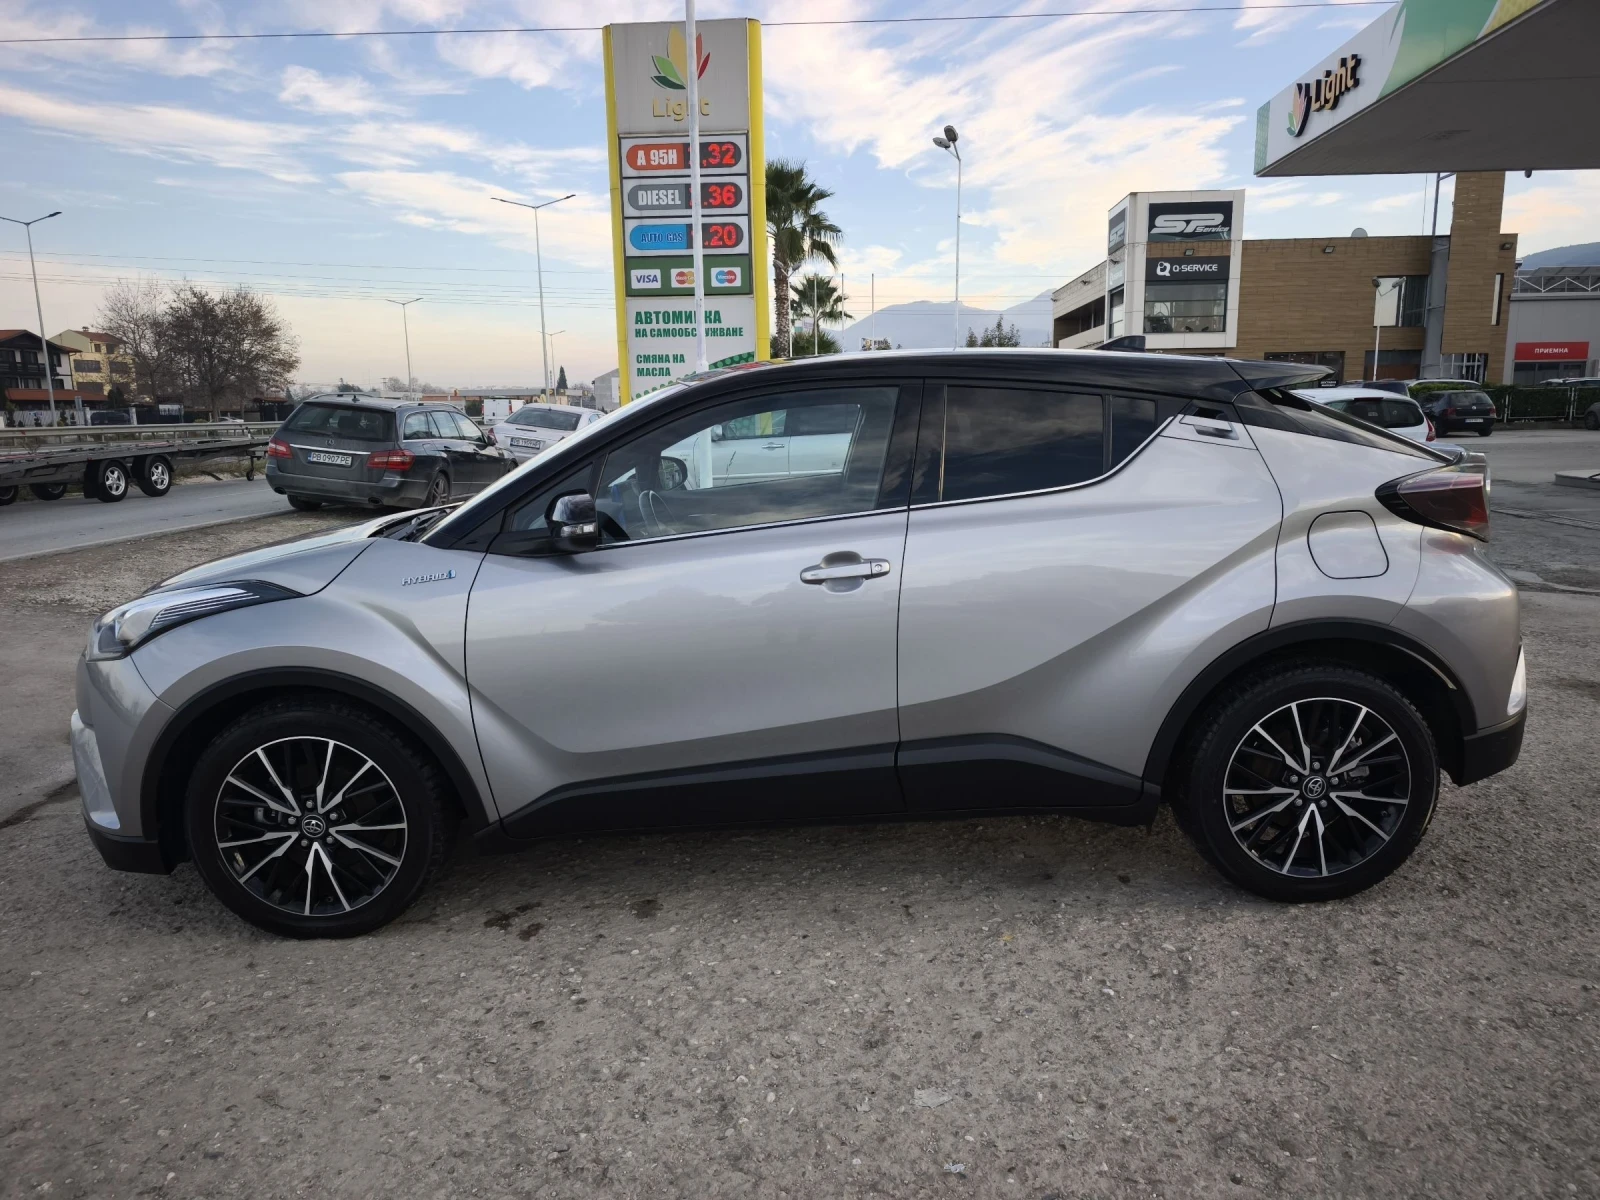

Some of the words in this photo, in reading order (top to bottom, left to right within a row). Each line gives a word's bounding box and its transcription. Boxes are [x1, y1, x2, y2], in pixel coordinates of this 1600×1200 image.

[1312, 54, 1361, 112] Light
[652, 97, 711, 122] Ligt
[636, 149, 647, 166] A
[638, 189, 681, 206] DIESEL
[1150, 213, 1225, 234] SP
[641, 232, 663, 243] AUTO
[666, 232, 684, 242] GAS
[635, 274, 659, 284] VISA
[634, 310, 722, 325] АВТОМИКА
[634, 328, 648, 338] НА
[649, 327, 744, 338] САМООБСУЖВАНЕ
[636, 354, 670, 364] СМЯНА
[672, 354, 686, 364] НА
[636, 367, 671, 377] МАСЛА
[322, 454, 340, 463] 0907
[401, 572, 447, 586] HYBRID
